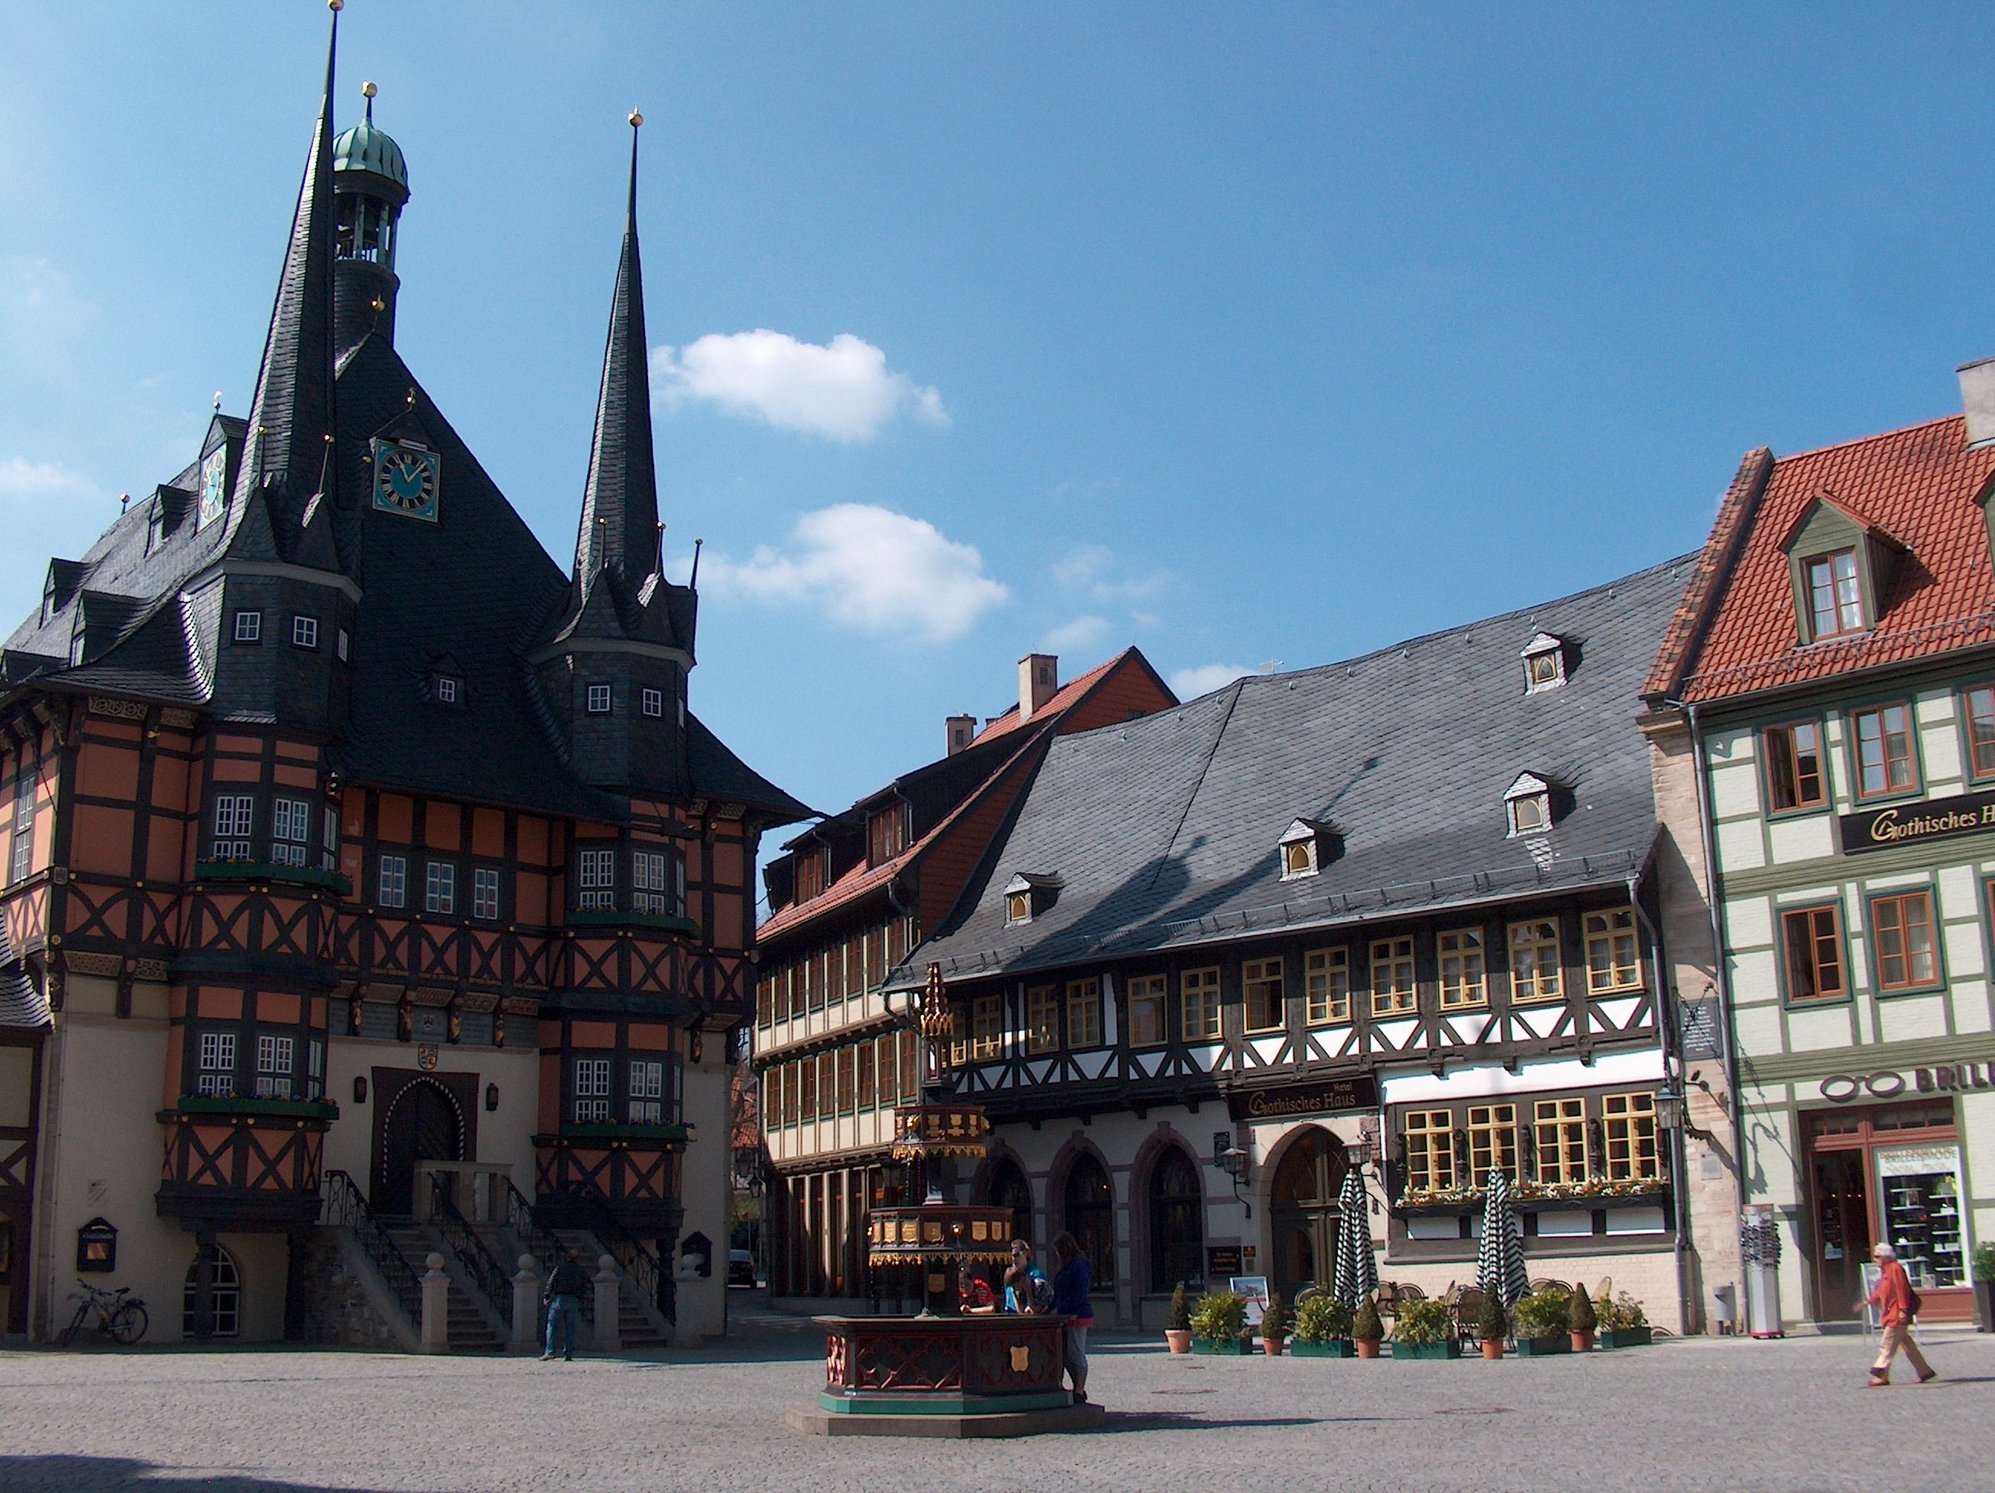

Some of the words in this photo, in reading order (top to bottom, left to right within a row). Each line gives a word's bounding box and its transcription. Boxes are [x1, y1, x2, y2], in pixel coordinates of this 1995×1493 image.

[1871, 809, 1977, 841] Gothisches
[1248, 1091, 1321, 1116] Gothisches
[1323, 1093, 1356, 1109] Haus
